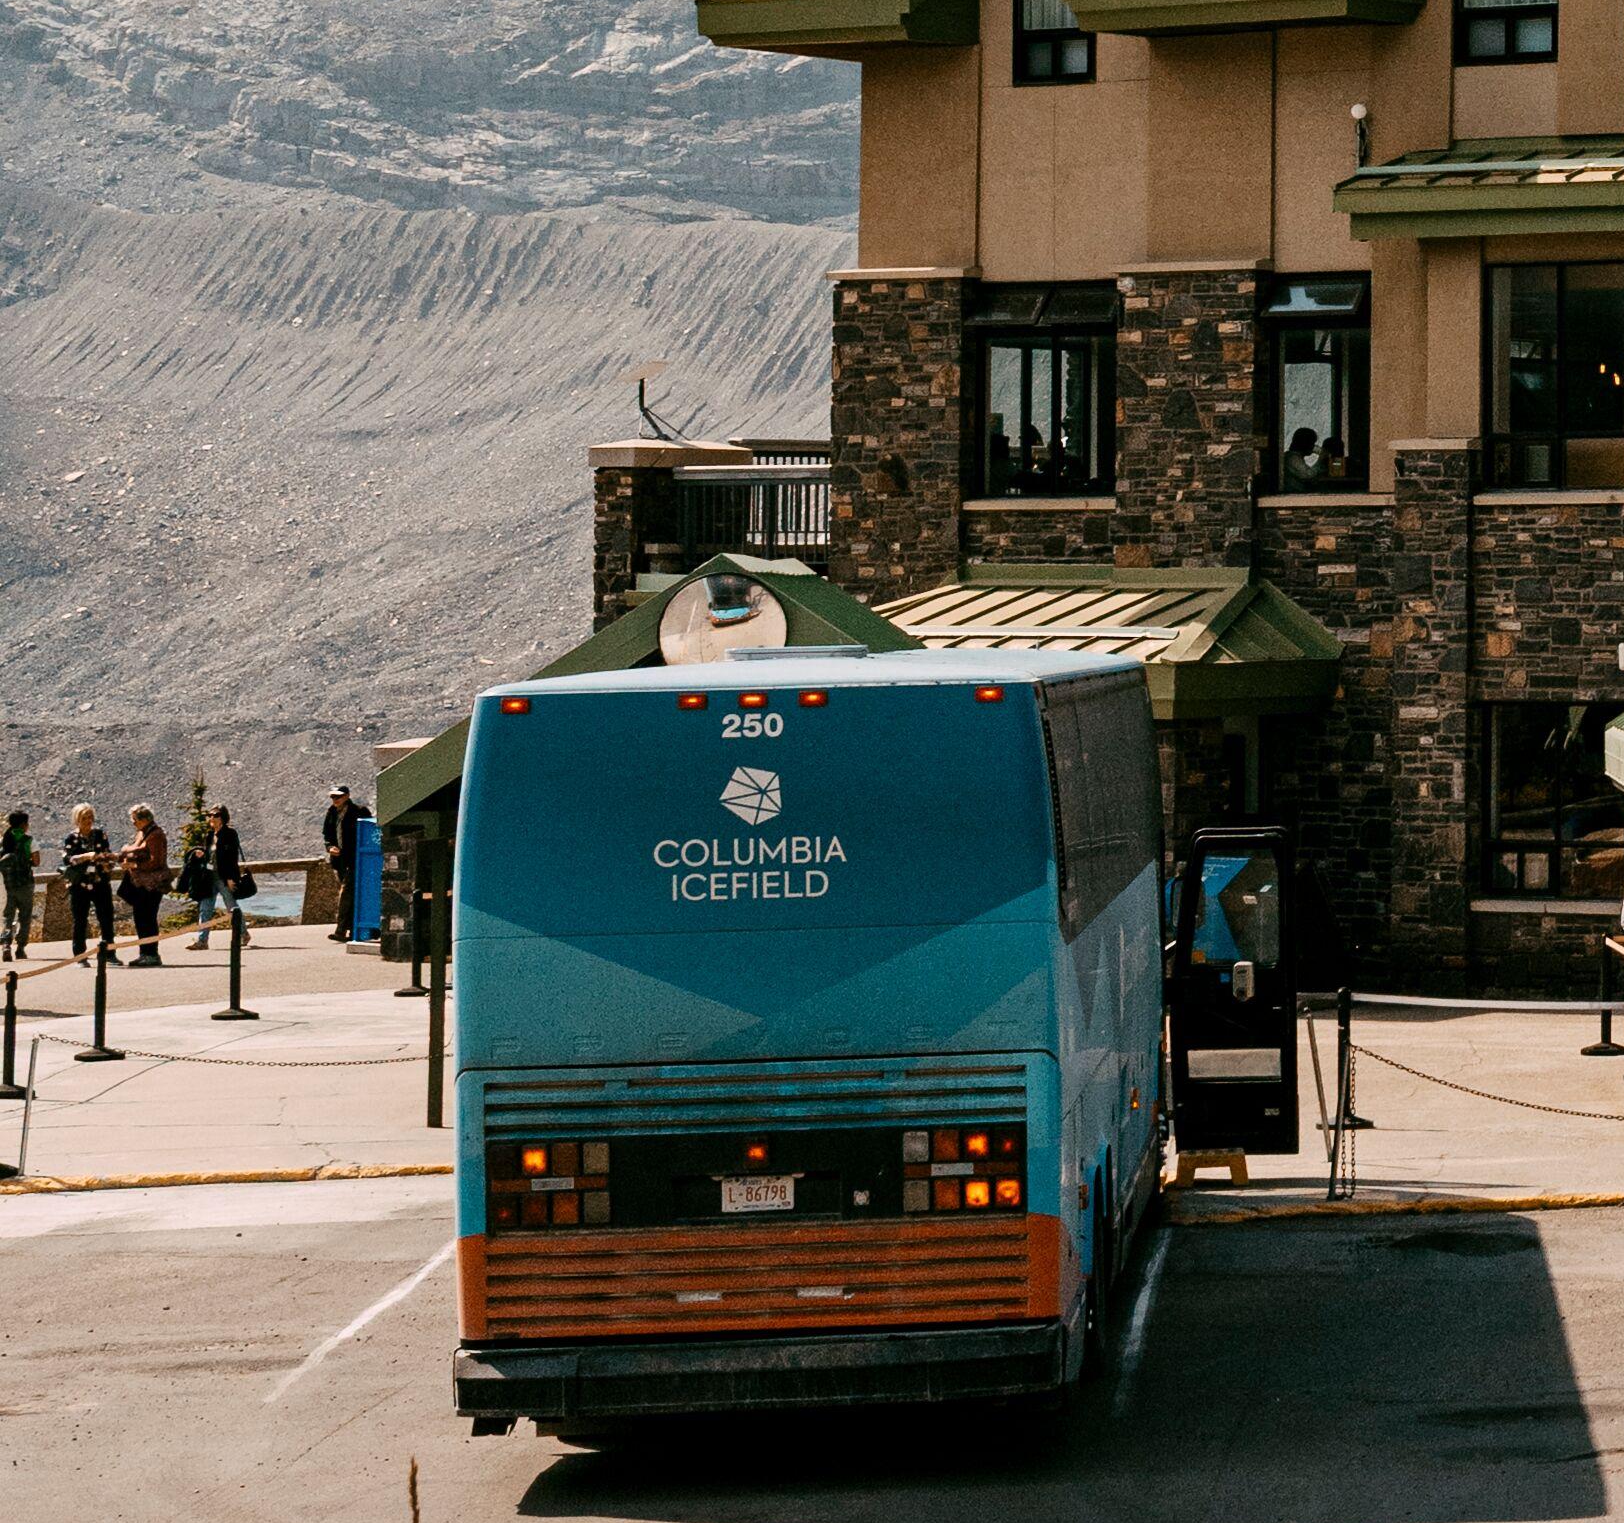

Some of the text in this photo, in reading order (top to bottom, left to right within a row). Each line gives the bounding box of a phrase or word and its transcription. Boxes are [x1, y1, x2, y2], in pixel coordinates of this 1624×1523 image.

[721, 713, 784, 738] 250
[653, 835, 848, 868] COLUMBIA
[672, 870, 829, 901] ICEFIELD
[491, 1019, 1018, 1059] PREOST
